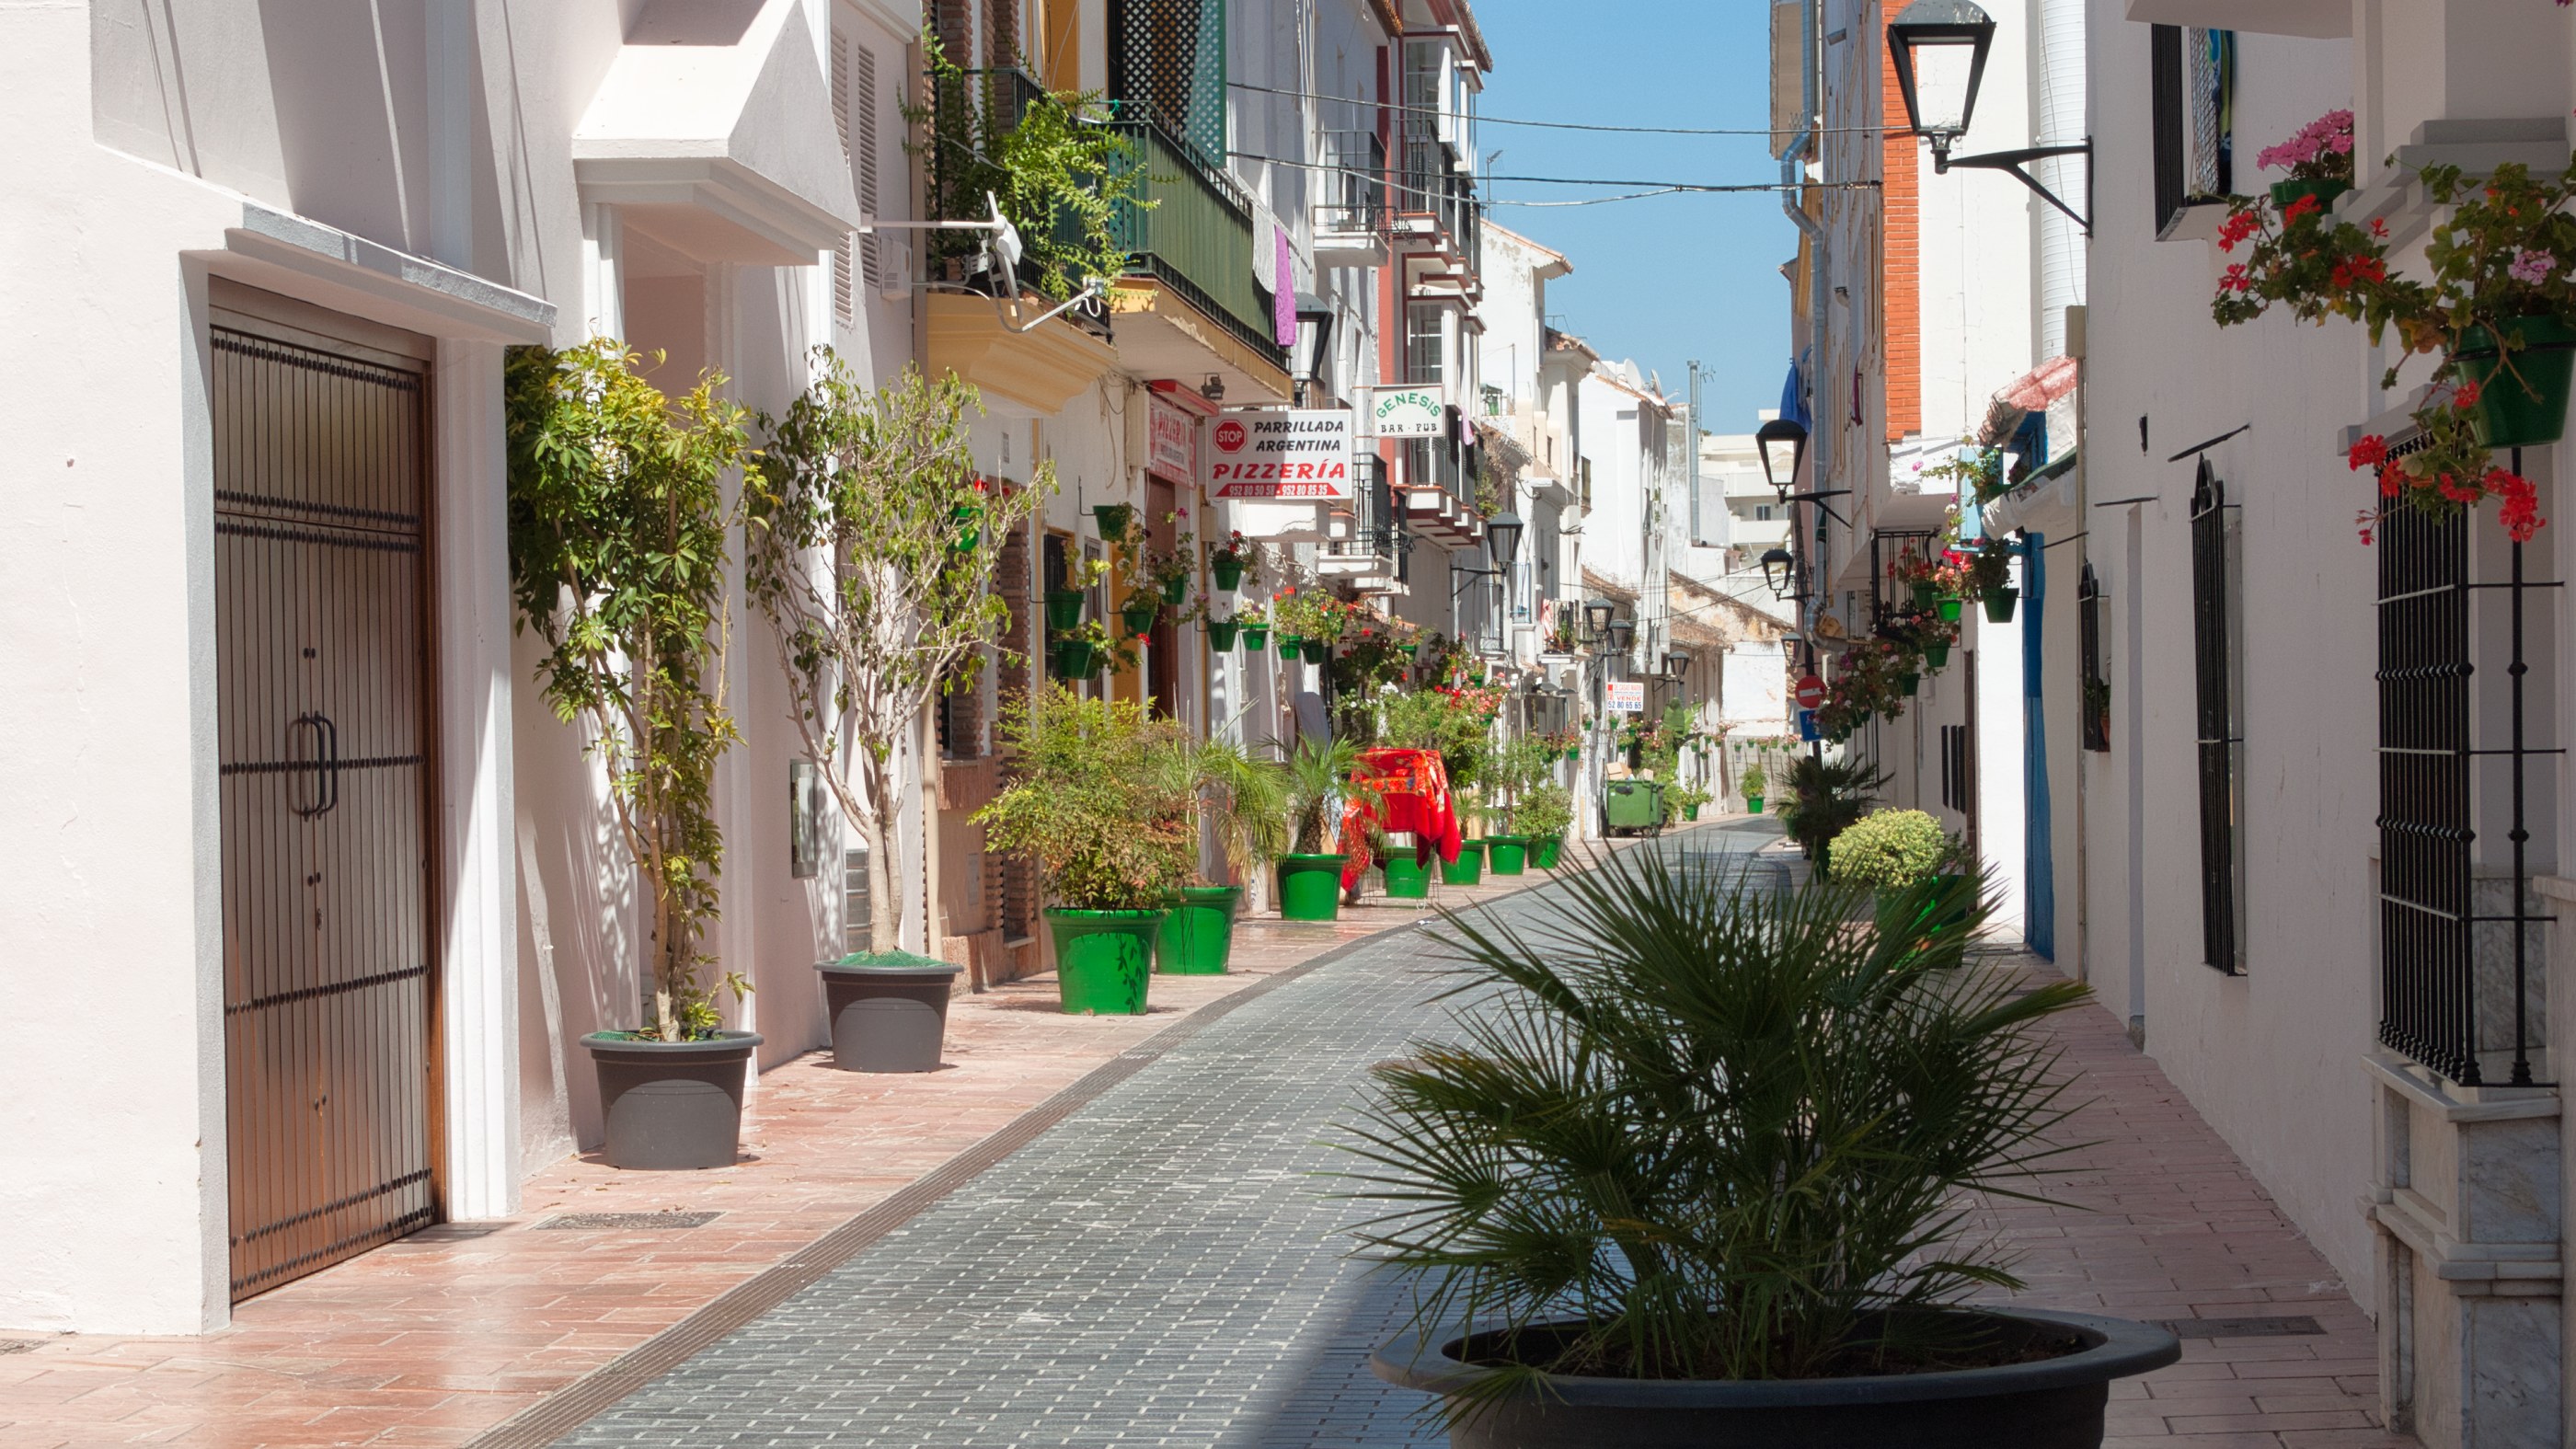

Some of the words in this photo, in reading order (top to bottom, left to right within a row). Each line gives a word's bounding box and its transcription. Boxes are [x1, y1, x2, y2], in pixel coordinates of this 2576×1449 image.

[1376, 393, 1442, 419] GENESIS
[1254, 420, 1344, 433] PARRILLADA
[1381, 424, 1404, 433] BAR
[1416, 423, 1437, 432] PUB
[1218, 431, 1242, 443] STOP
[1256, 440, 1340, 453] ARGENTINA
[1213, 458, 1345, 480] PIZZERÍA
[1229, 485, 1242, 496] 952
[1244, 485, 1254, 496] 80
[1254, 485, 1264, 496] 50
[1266, 485, 1275, 496] 58
[1282, 484, 1296, 496] 952
[1296, 484, 1306, 495] 80
[1307, 484, 1317, 495] 85
[1318, 484, 1328, 495] 35
[1616, 701, 1625, 709] 80
